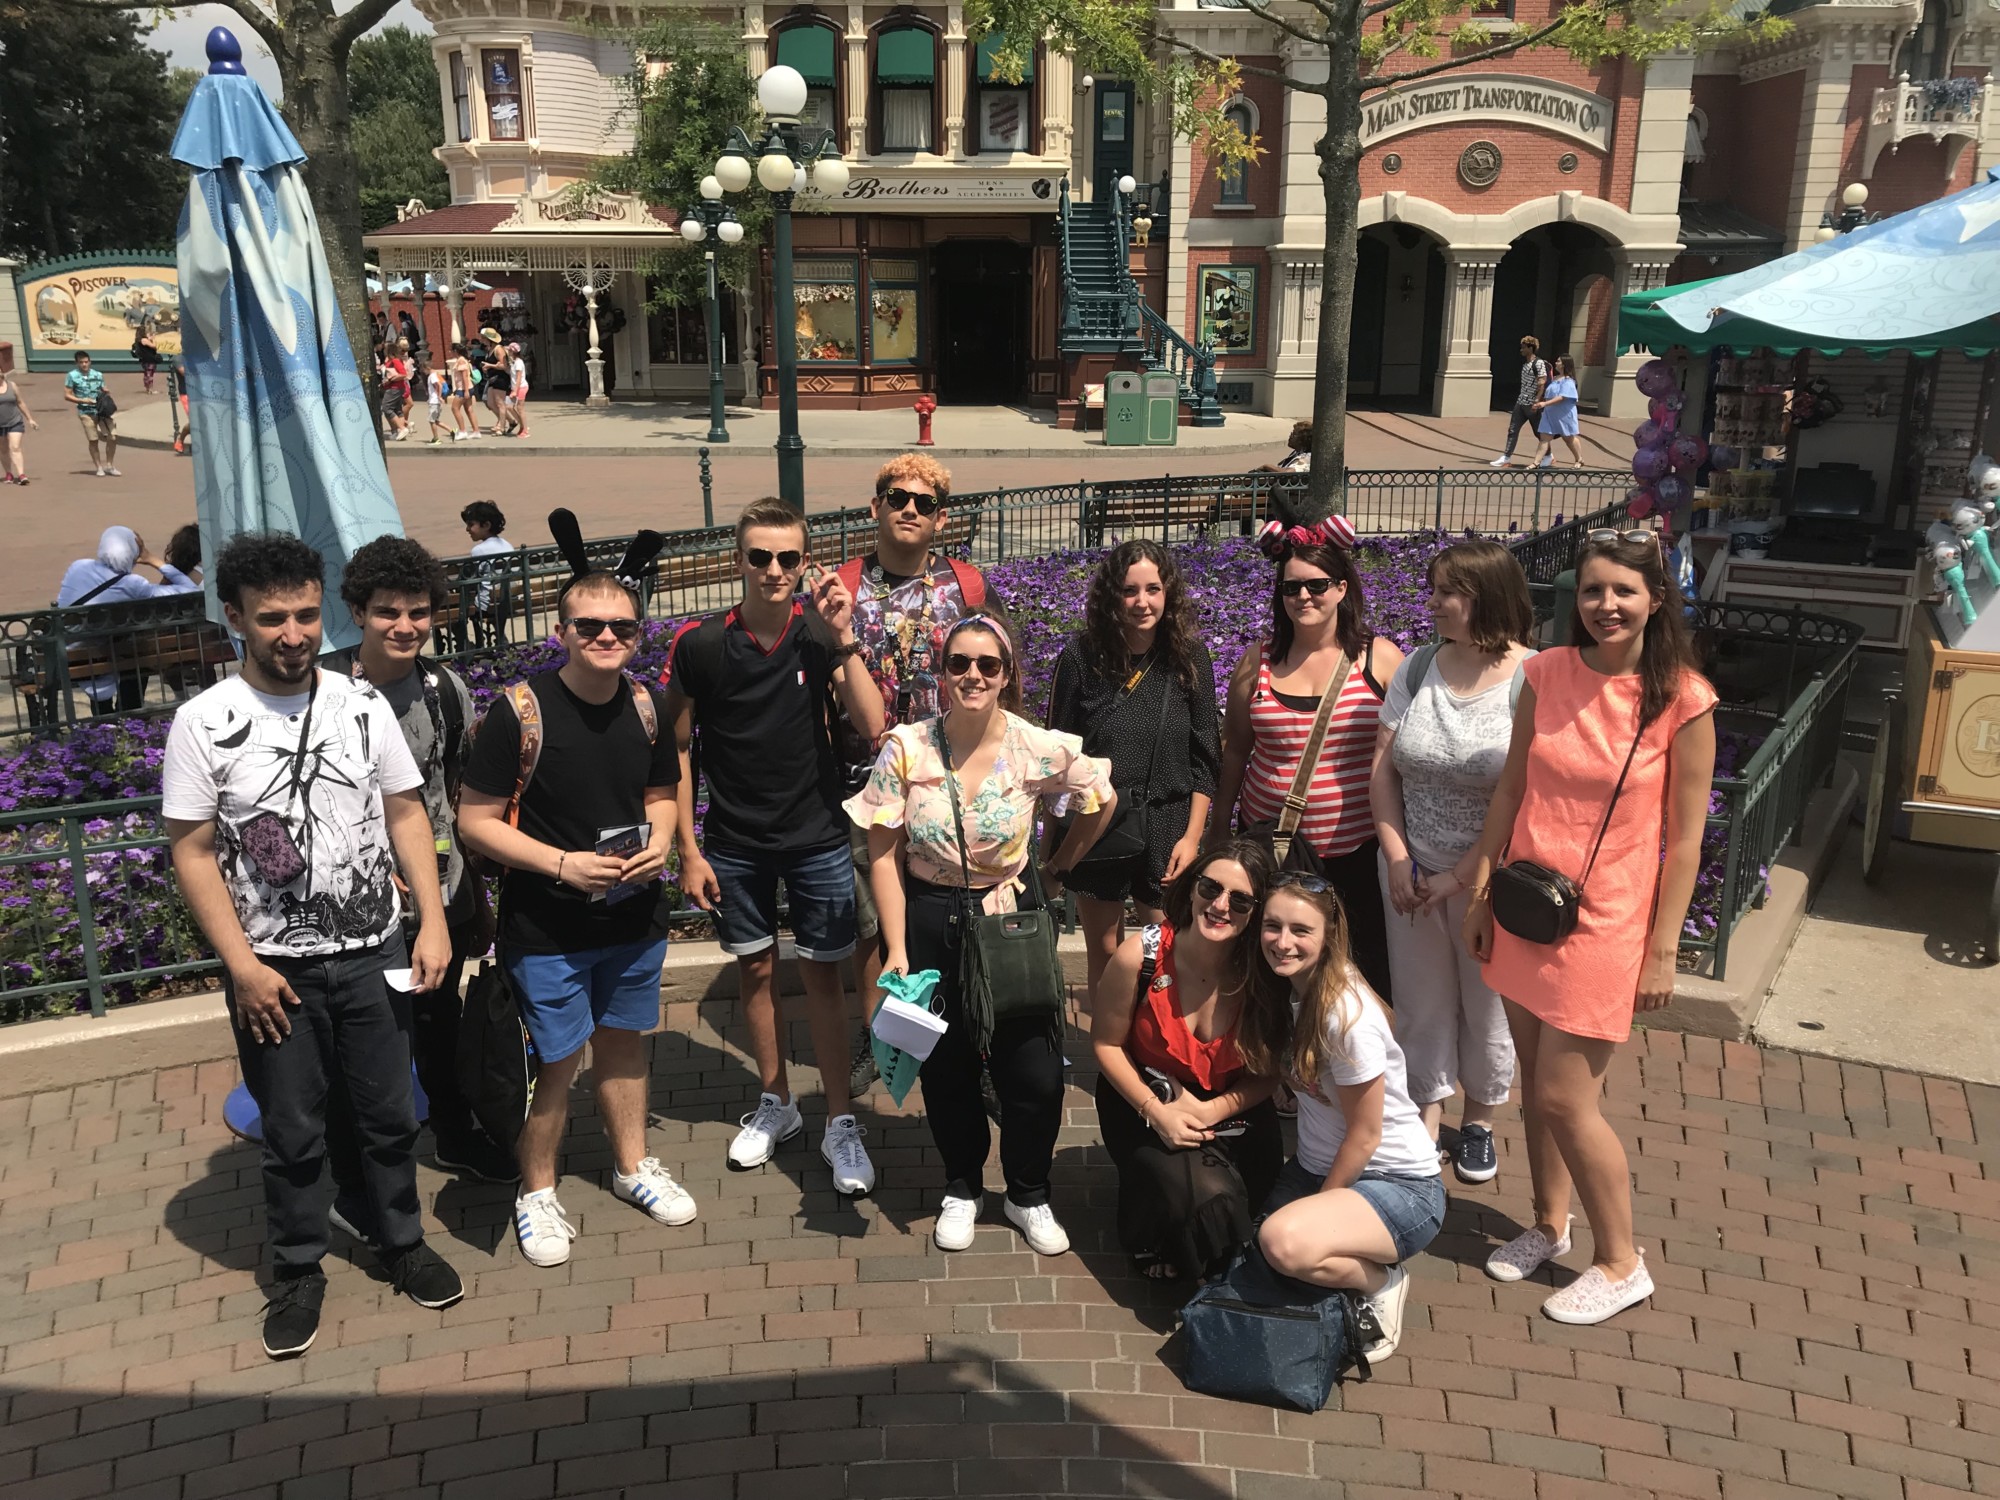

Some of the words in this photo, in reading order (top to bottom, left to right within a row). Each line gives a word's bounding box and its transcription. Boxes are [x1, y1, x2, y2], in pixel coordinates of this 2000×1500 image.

[1366, 99, 1405, 137] MAIN
[1408, 90, 1460, 120] STREET
[1462, 85, 1578, 123] TRANSPORTATION
[1562, 155, 1574, 168] 2
[842, 177, 950, 200] Brothers
[68, 276, 130, 297] DISCOVER
[1126, 670, 1143, 690] Nikon
